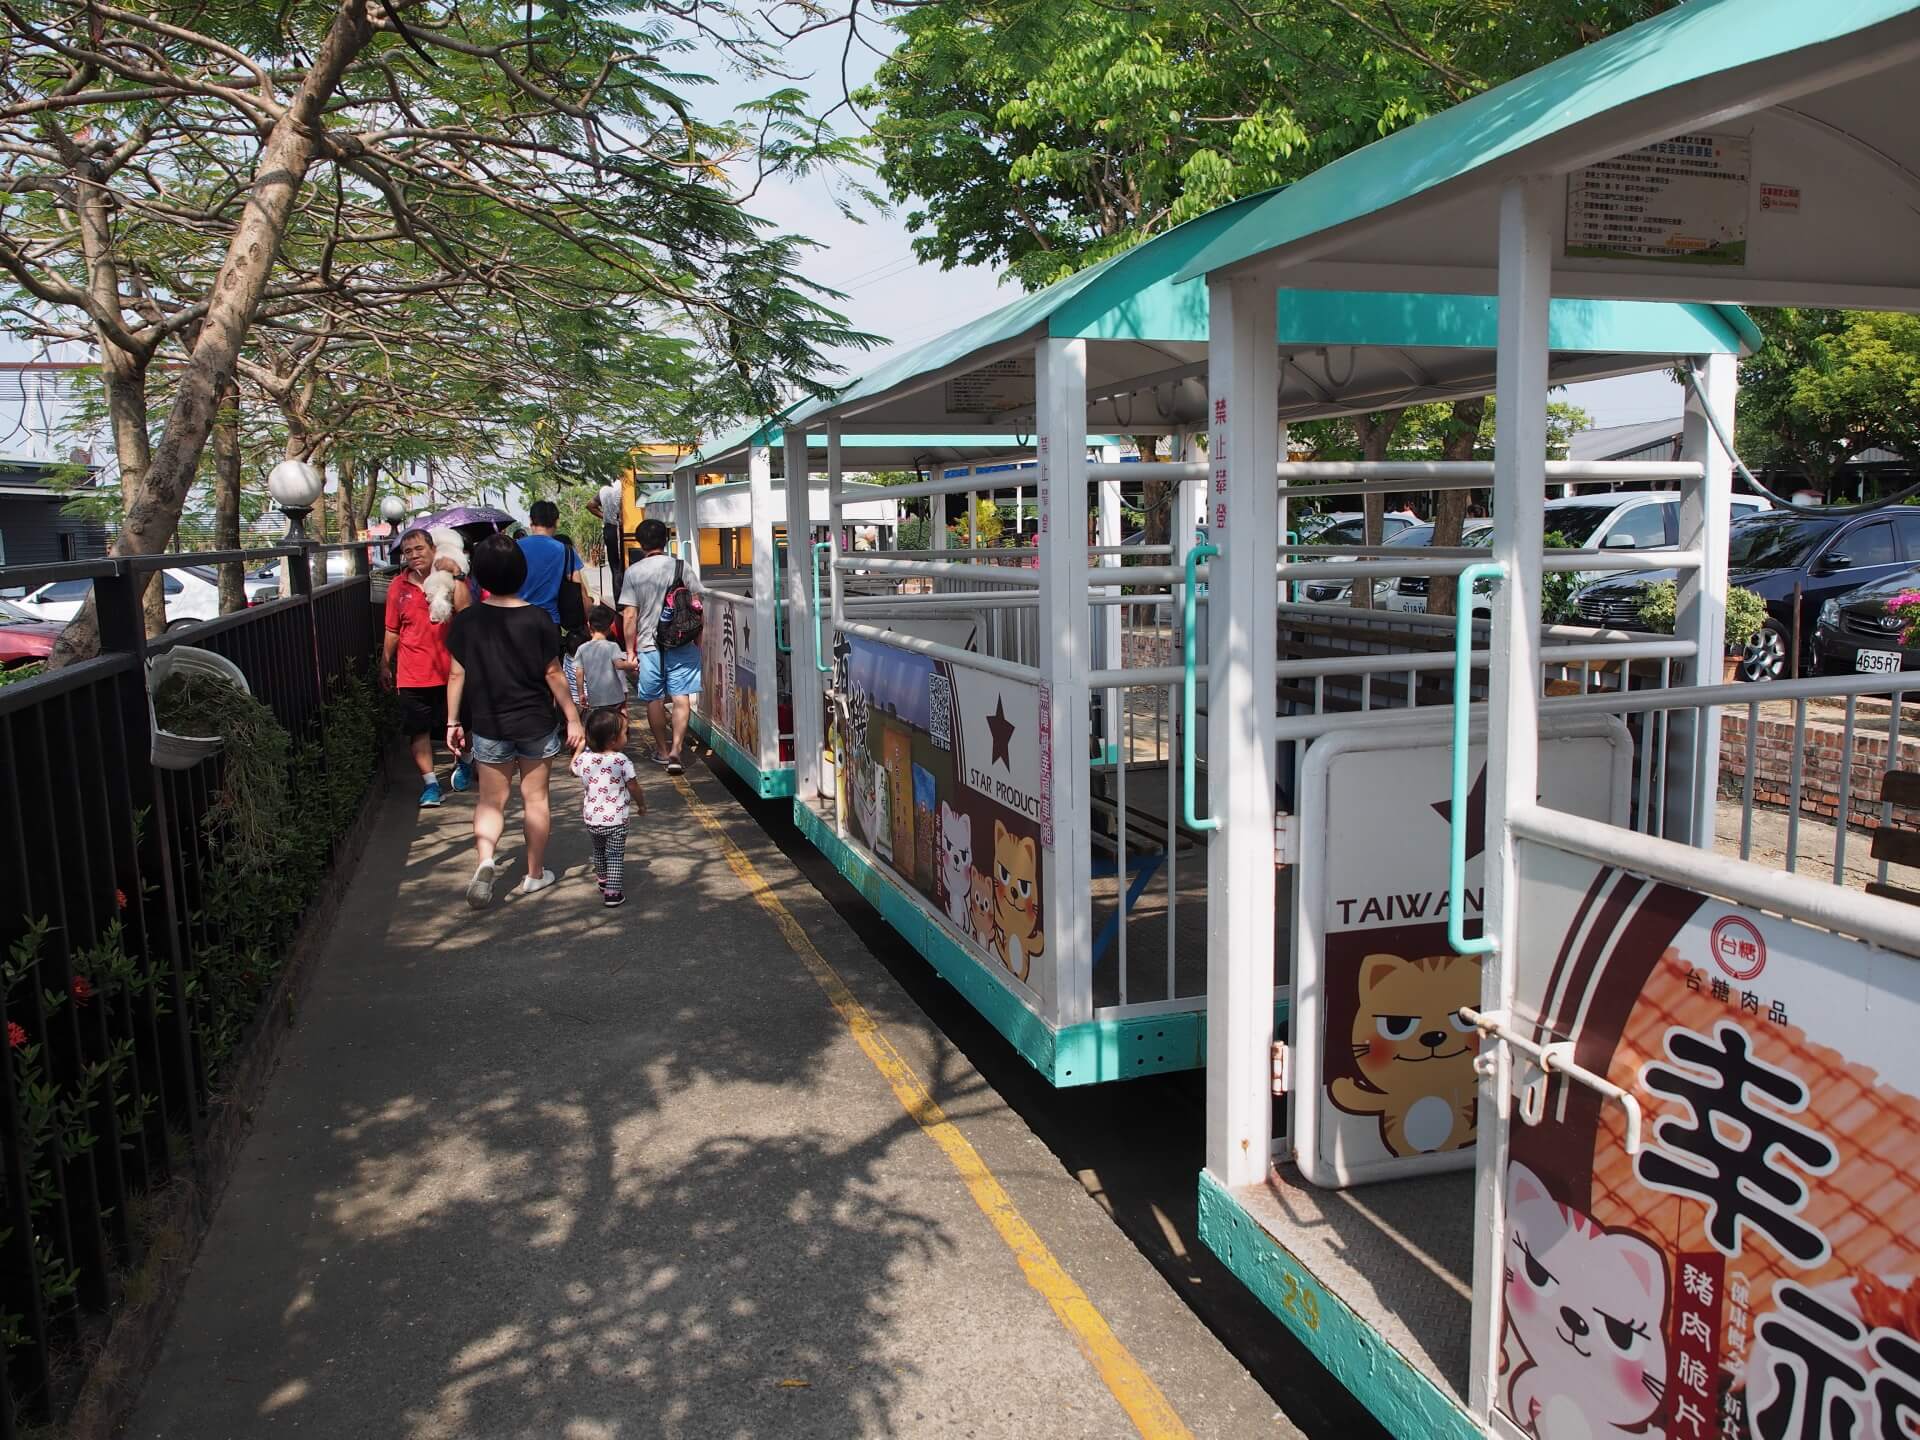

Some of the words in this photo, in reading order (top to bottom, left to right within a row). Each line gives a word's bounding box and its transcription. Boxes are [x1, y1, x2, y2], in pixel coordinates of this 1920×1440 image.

[1215, 397, 1227, 529] 禁止攀登
[970, 767, 993, 794] STAR
[995, 780, 1041, 818] PRODUCT
[1720, 934, 1757, 963] 台糖
[1684, 967, 1788, 1027] 台糖肉品
[1283, 1271, 1320, 1330] 29
[1674, 1262, 1715, 1438] 豬肉脆片
